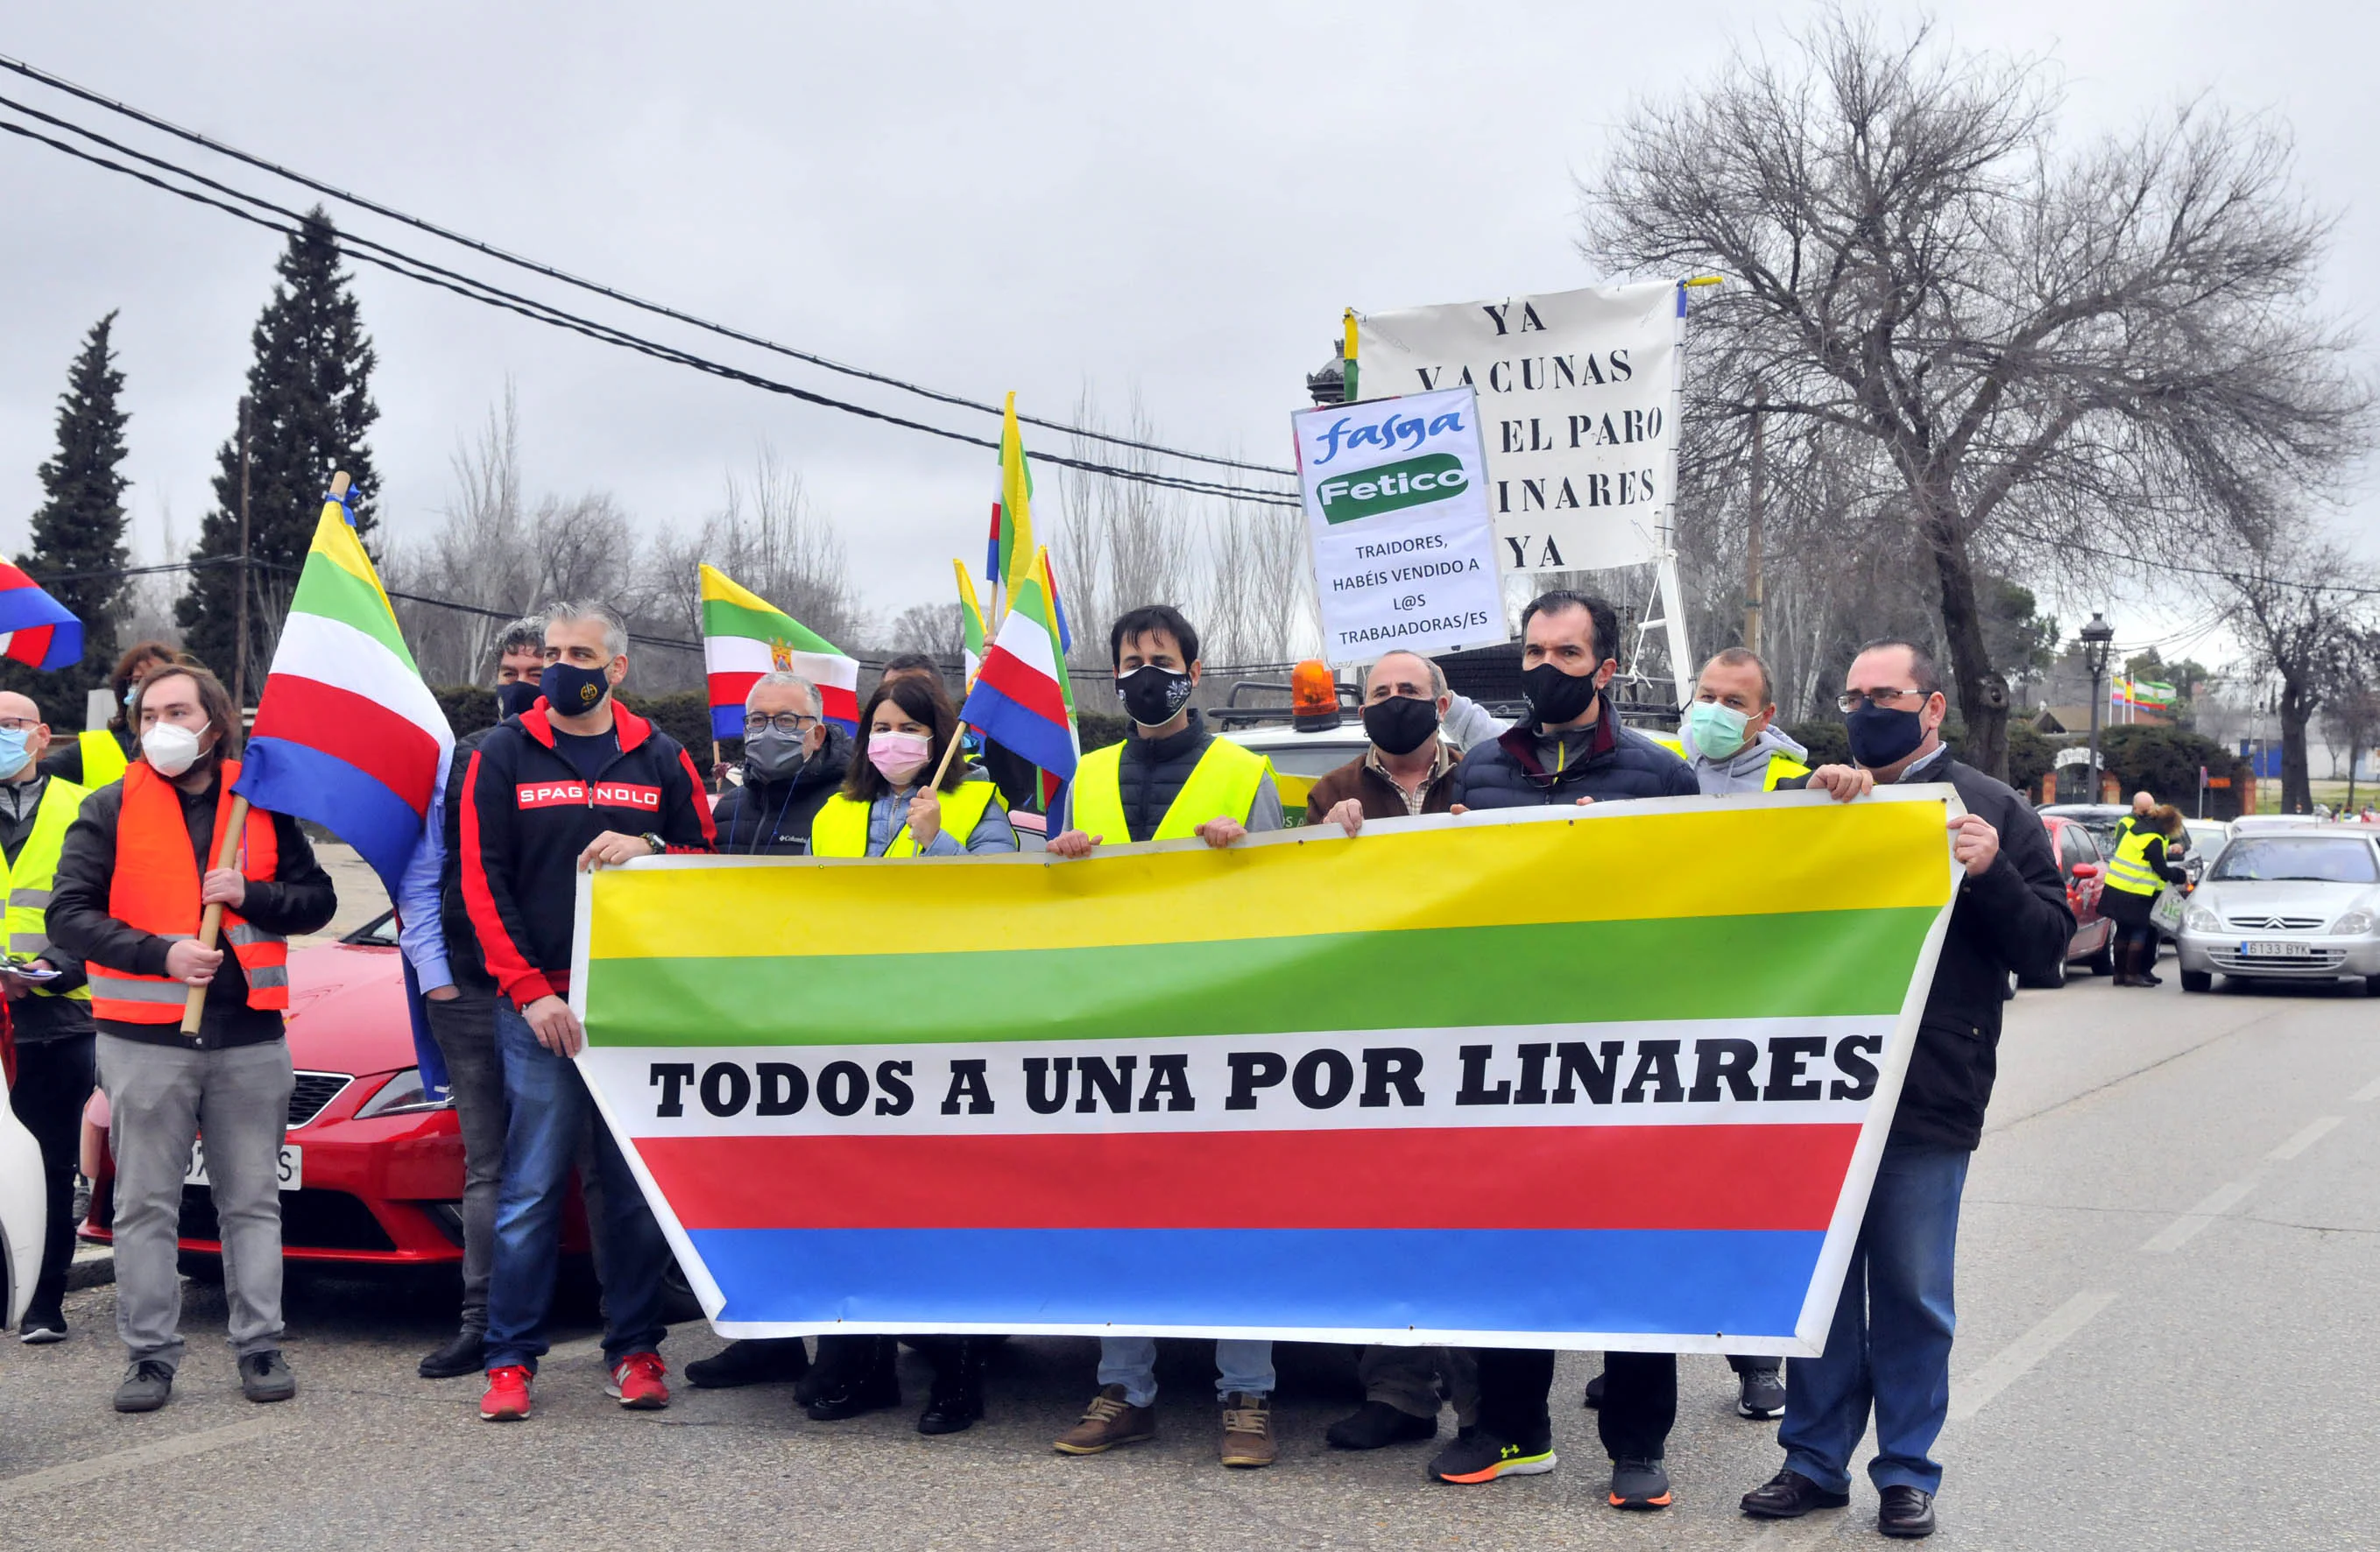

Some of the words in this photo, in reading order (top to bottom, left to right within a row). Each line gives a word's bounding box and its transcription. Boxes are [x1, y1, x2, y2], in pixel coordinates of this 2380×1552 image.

[1482, 300, 1547, 335] YA
[1415, 349, 1633, 396] VACUNAS
[1313, 412, 1465, 465] fasga
[1501, 418, 1552, 453] EL
[1568, 406, 1663, 448] PARO
[1320, 469, 1467, 505] Fetico
[1497, 469, 1655, 513] INARES
[1355, 534, 1448, 560] TRAIDORES,
[1504, 534, 1565, 568] YA
[1332, 570, 1388, 591] HABÉIS
[1391, 560, 1464, 582] VENDIDO
[1469, 558, 1480, 571] A
[1393, 594, 1426, 610] L@S
[1338, 610, 1487, 645] TRABAJADORAS/ES
[2249, 943, 2281, 955] 6133
[2285, 944, 2308, 956] BYK
[650, 1060, 915, 1118] TODOS
[941, 1059, 995, 1115] A
[1022, 1054, 1196, 1115] UNA
[1225, 1048, 1425, 1111] POR
[1455, 1034, 1883, 1106] LINARES
